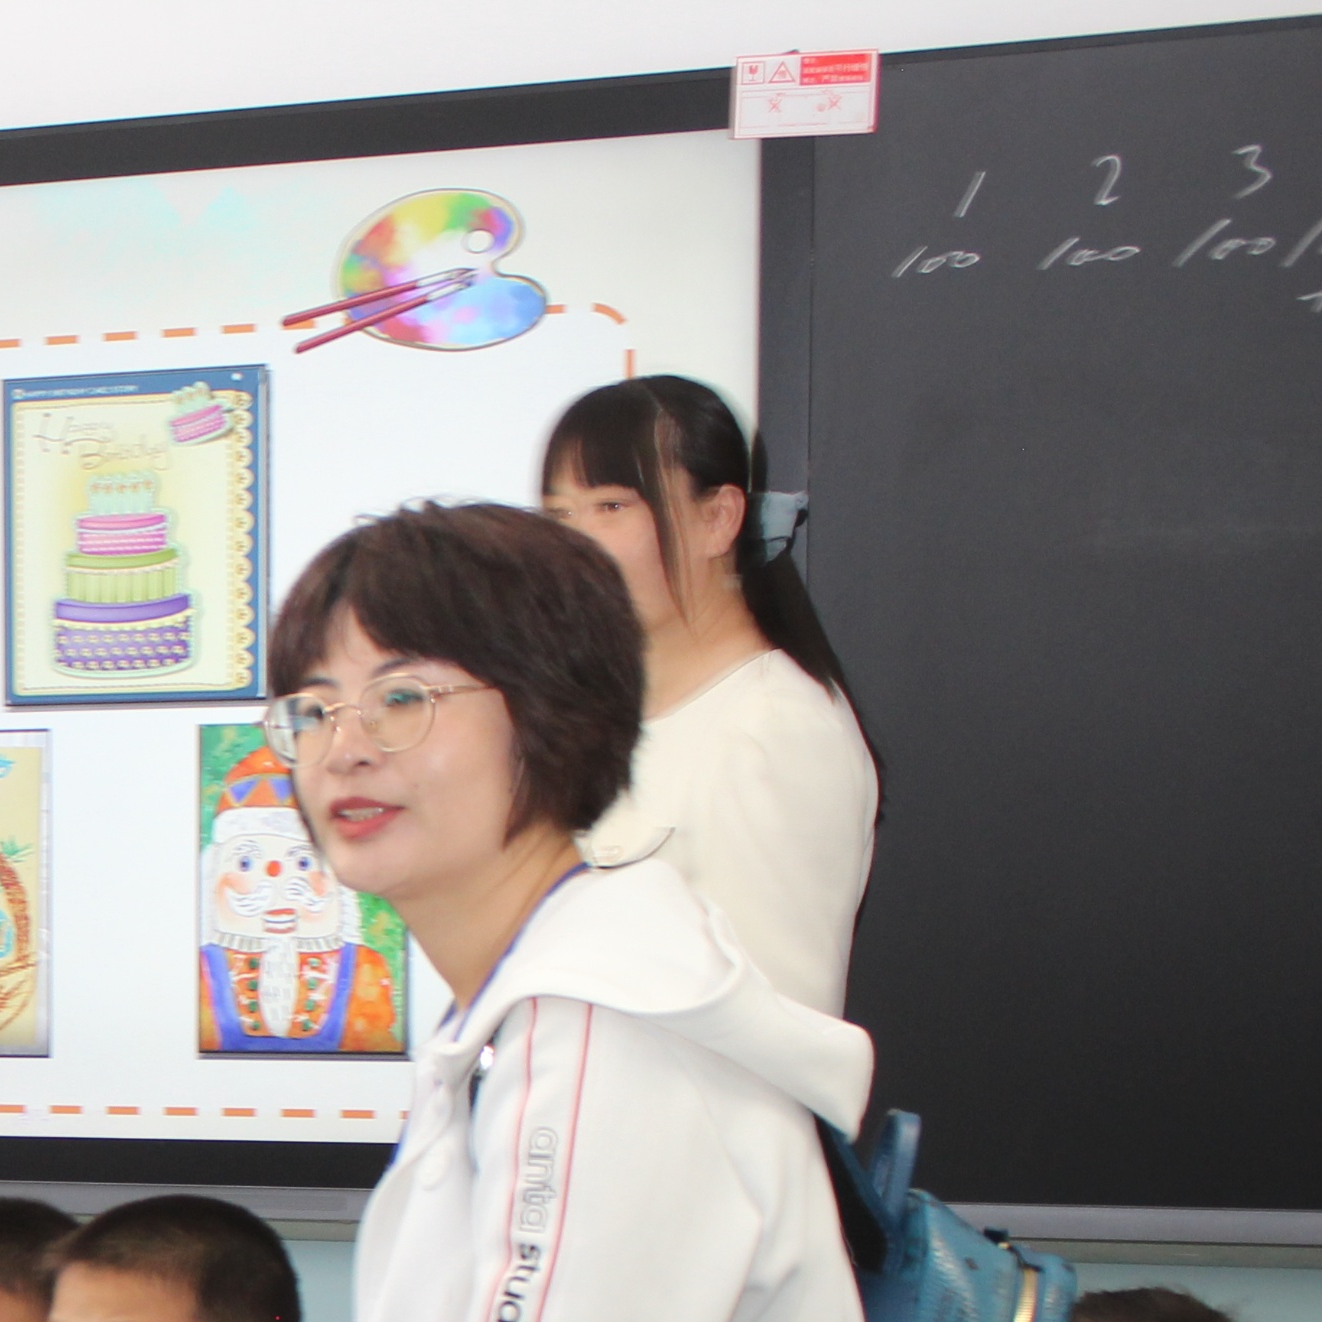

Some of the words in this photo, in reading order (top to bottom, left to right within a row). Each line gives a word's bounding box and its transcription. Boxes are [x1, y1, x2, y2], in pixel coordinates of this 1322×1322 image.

[953, 170, 986, 218] 1
[1092, 154, 1122, 206] 2
[1234, 144, 1272, 199] 3
[892, 246, 981, 278] 100
[1038, 237, 1141, 270] 100
[1171, 218, 1276, 268] 100
